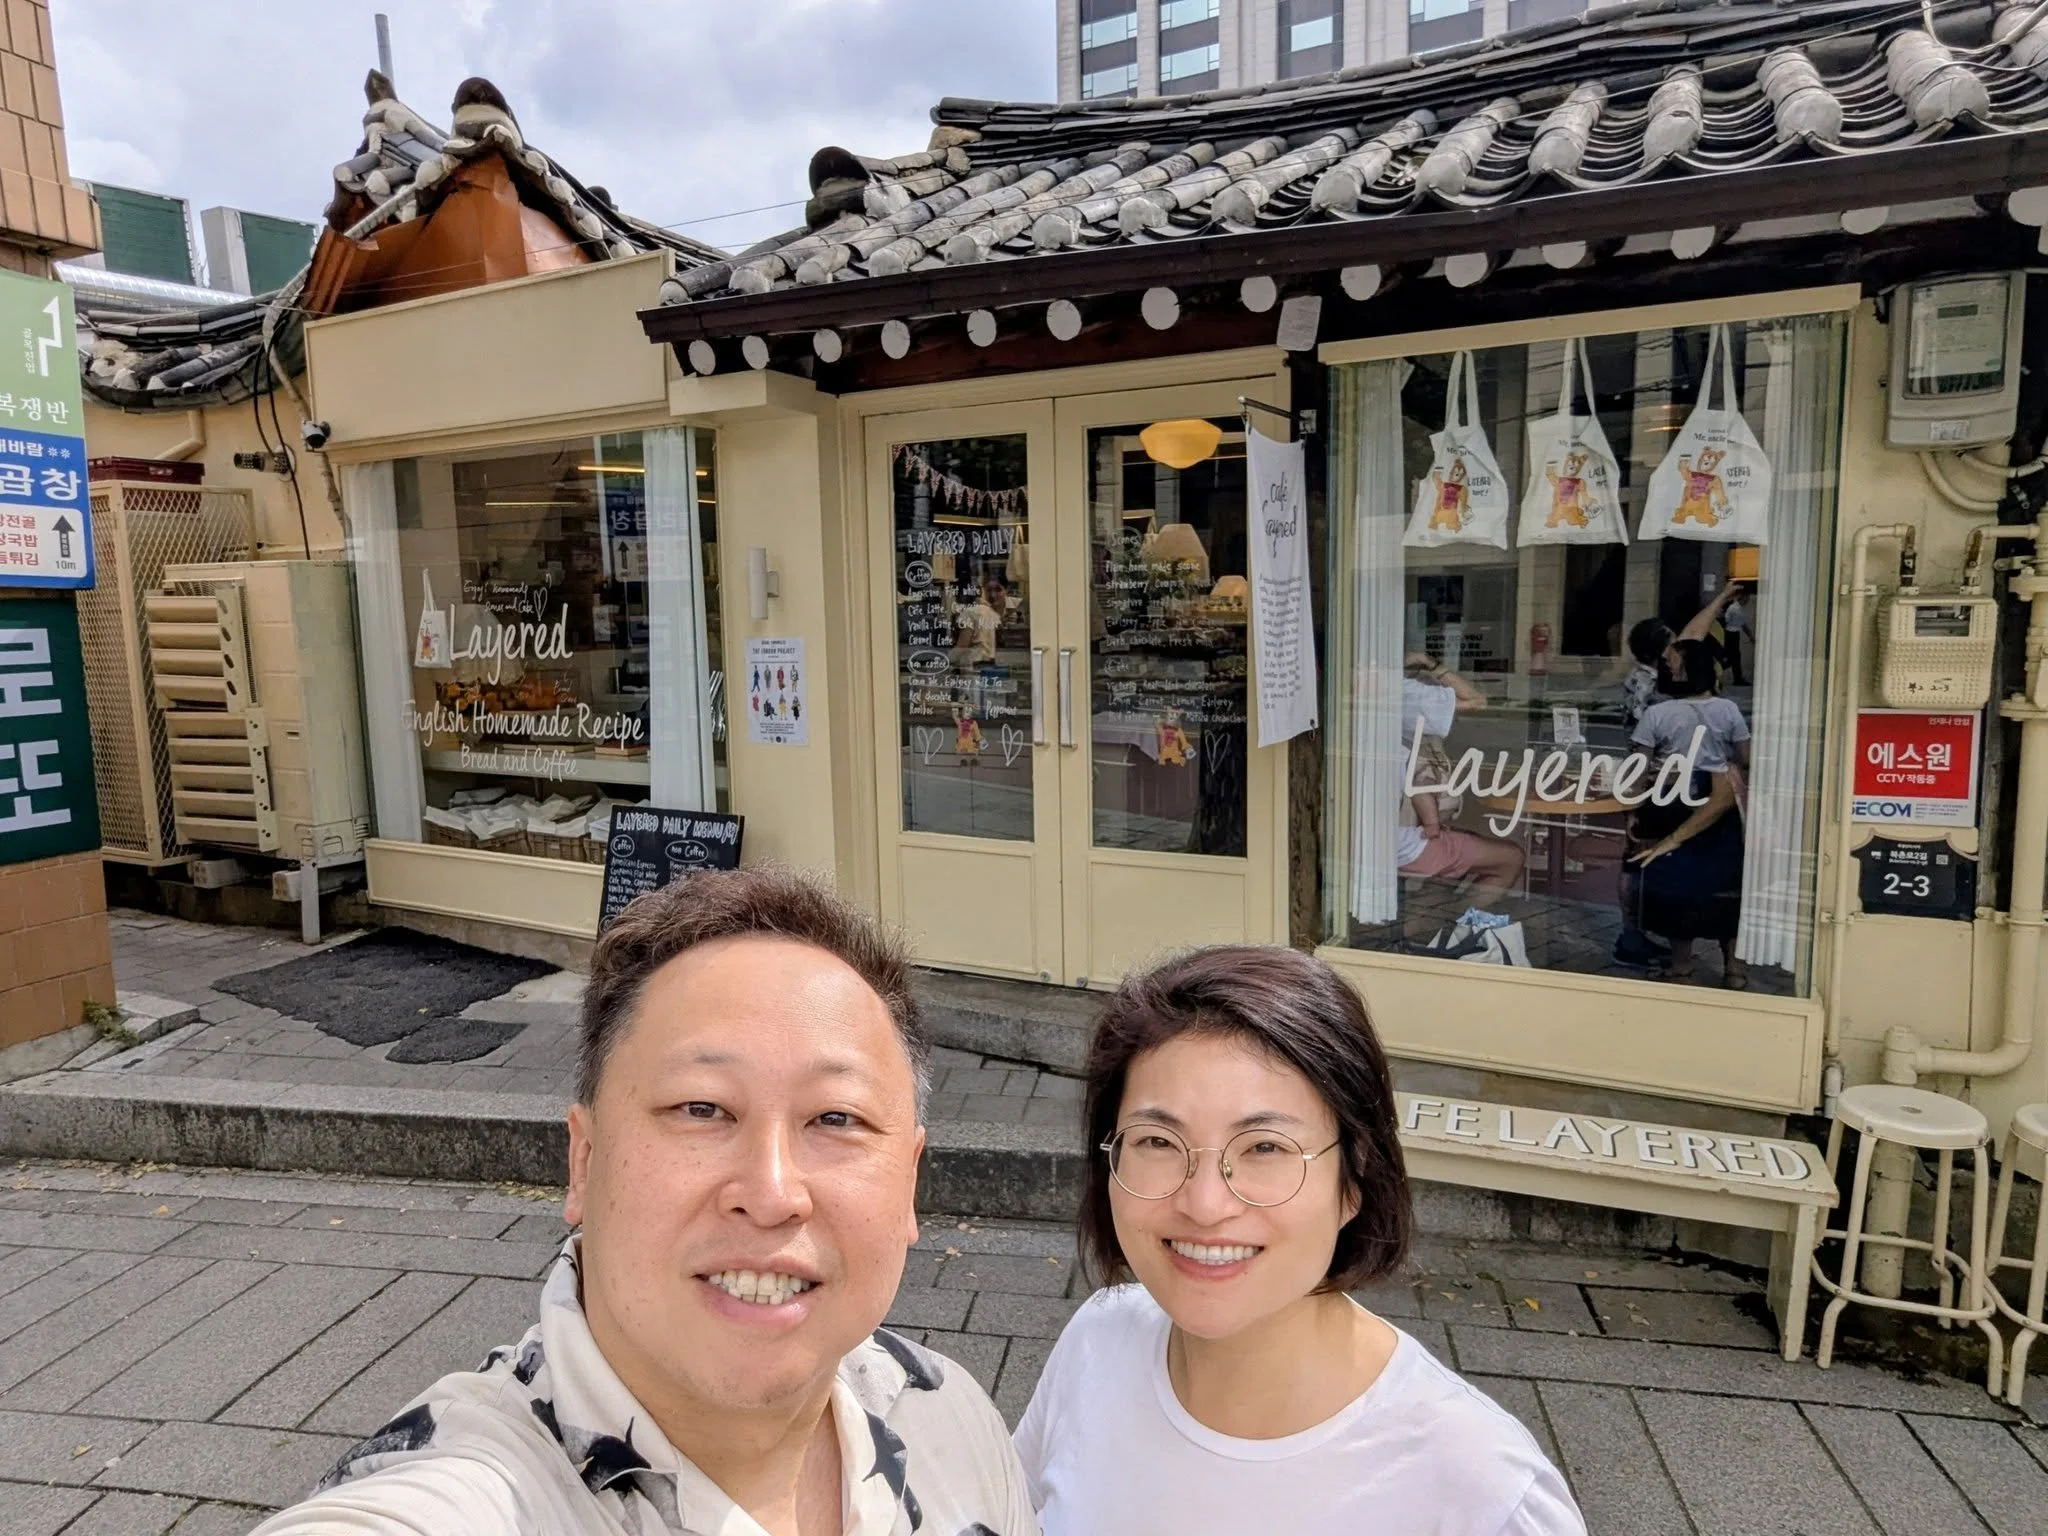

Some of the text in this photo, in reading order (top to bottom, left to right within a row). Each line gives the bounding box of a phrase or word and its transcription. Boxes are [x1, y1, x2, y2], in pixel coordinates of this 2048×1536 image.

[0, 463, 82, 501] 곱창
[907, 528, 1015, 556] LAYERED DAILY
[55, 560, 77, 570] 10m
[449, 603, 574, 686] Layered
[402, 699, 645, 750] English Homemade Recipe
[461, 743, 579, 782] Bread and Coffee
[1867, 742, 1952, 771] 에스원
[1404, 715, 1710, 837] Layered
[1876, 773, 1937, 785] CCTV 작동중
[662, 815, 692, 838] DAILY
[1882, 873, 1930, 897] 2-3
[1499, 1109, 1812, 1182] LAYERED
